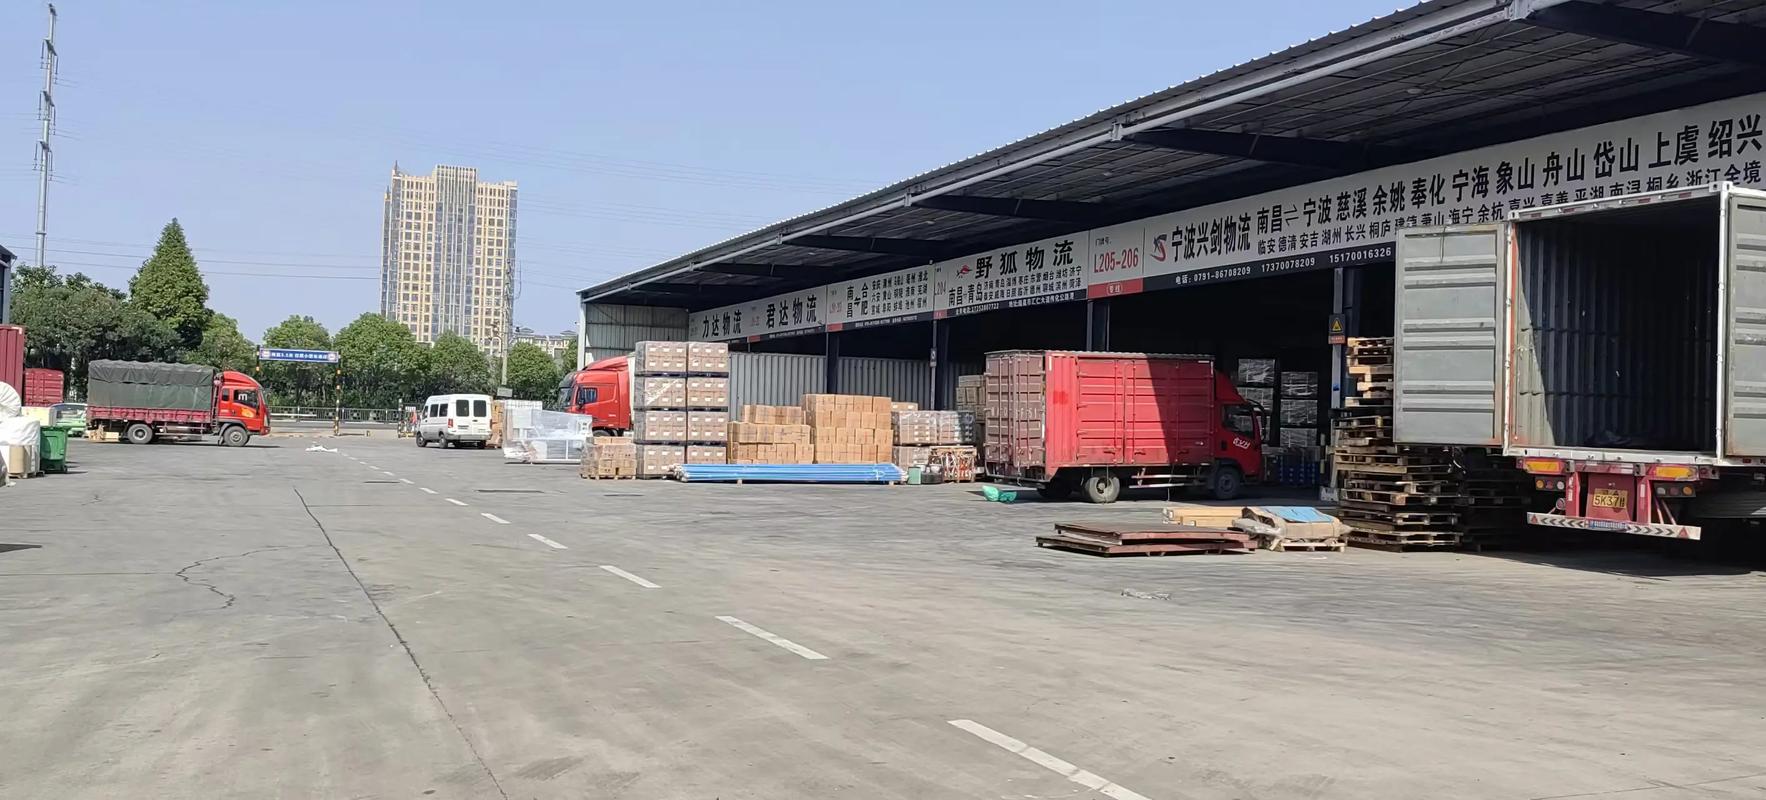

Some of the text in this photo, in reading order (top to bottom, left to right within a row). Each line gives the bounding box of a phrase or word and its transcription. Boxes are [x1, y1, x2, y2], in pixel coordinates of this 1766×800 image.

[1257, 113, 1763, 236] 南昌 宁波 慈溪 余姚 奉化 宁海 象山 舟山 岱山 上虞 绍兴
[1171, 212, 1251, 263] 宁波兴剑物流
[1257, 236, 1276, 256] 临安
[1278, 233, 1298, 252] 德清
[1299, 230, 1319, 249] 安吉
[1321, 226, 1342, 246] 湖州
[1344, 222, 1366, 243] 长兴
[1369, 218, 1391, 239] 桐庐
[1449, 206, 1473, 224] 海宁
[1477, 201, 1504, 223] 余杭
[975, 239, 1074, 280] 野狐物流
[1094, 247, 1139, 273] L205-206
[1261, 257, 1316, 273] 17370078209
[1329, 247, 1392, 264] 15170016326
[702, 309, 742, 338] 力达物流
[766, 294, 817, 329] 君达物流
